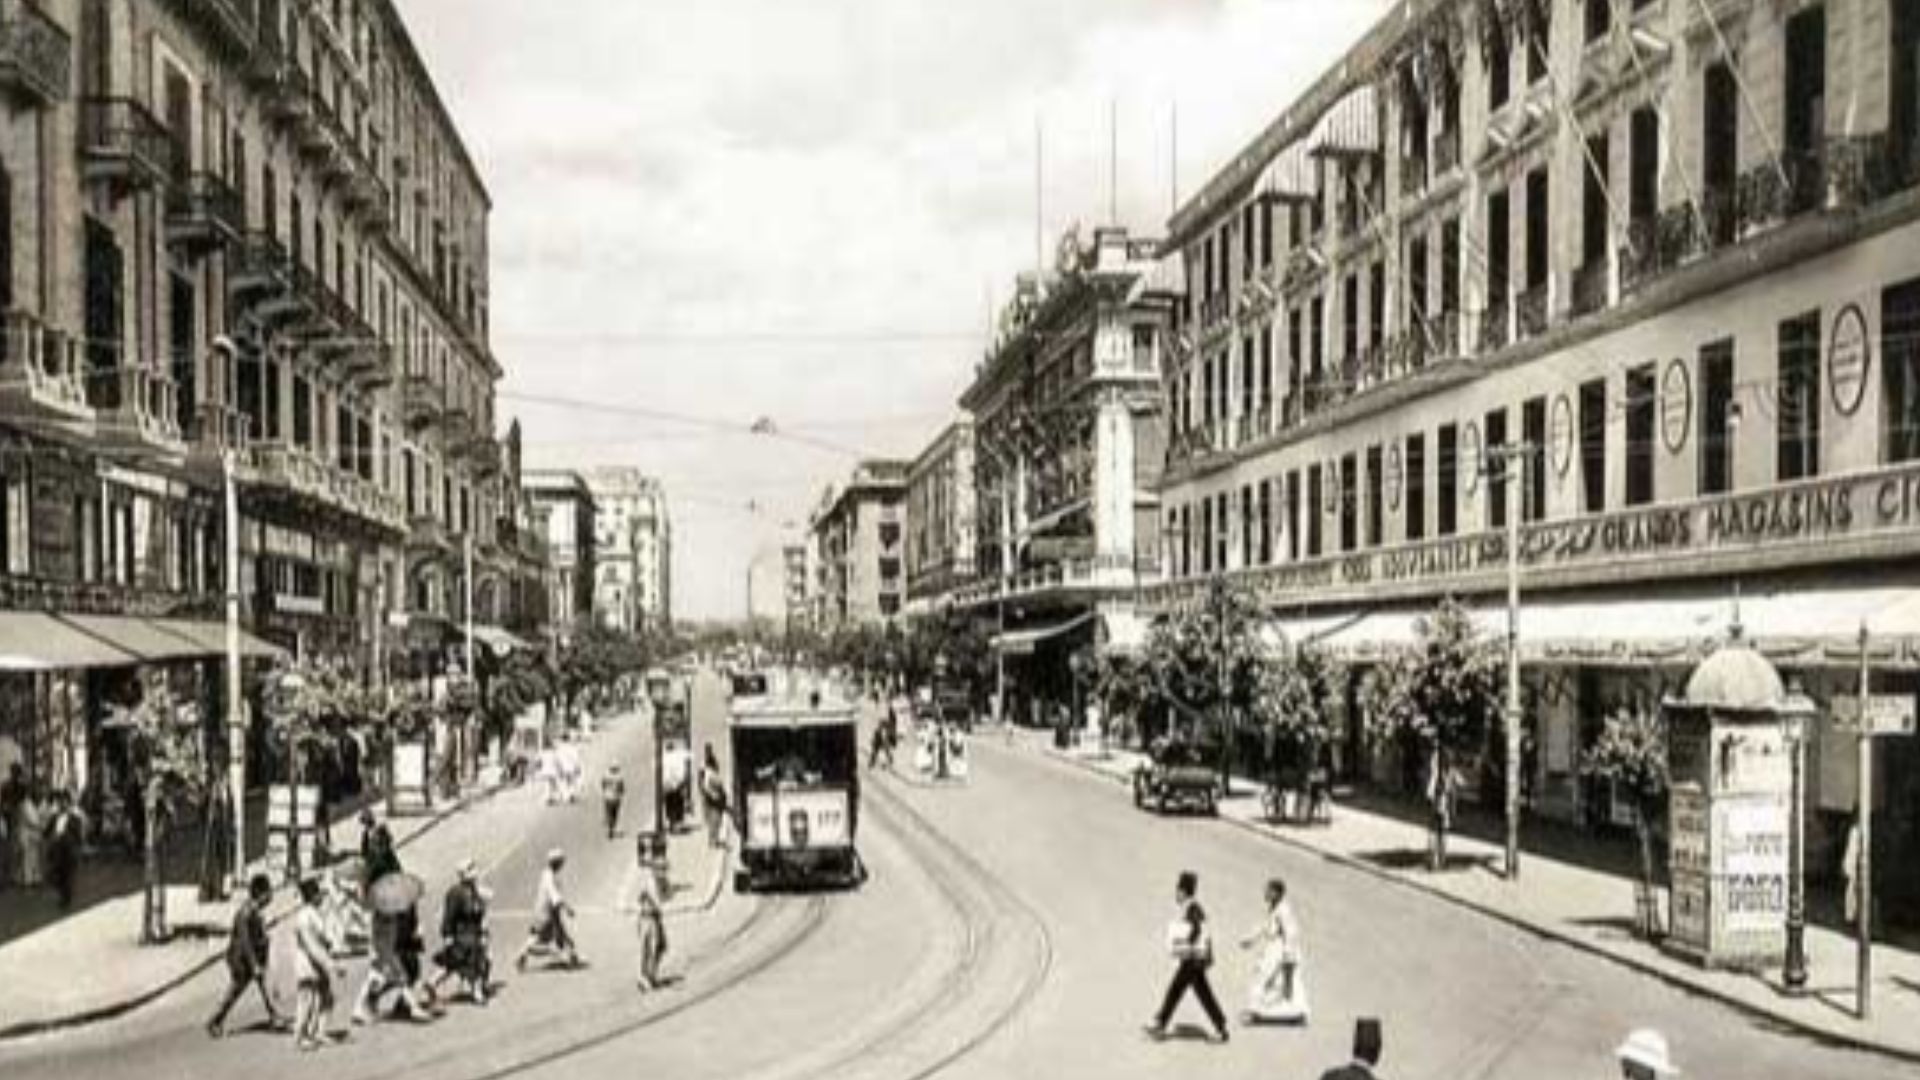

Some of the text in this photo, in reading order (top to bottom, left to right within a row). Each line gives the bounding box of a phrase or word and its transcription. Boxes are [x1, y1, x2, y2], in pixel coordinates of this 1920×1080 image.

[1602, 507, 1691, 553] GRANDS
[1706, 484, 1853, 542] MAGASINS
[1877, 475, 1920, 526] CI
